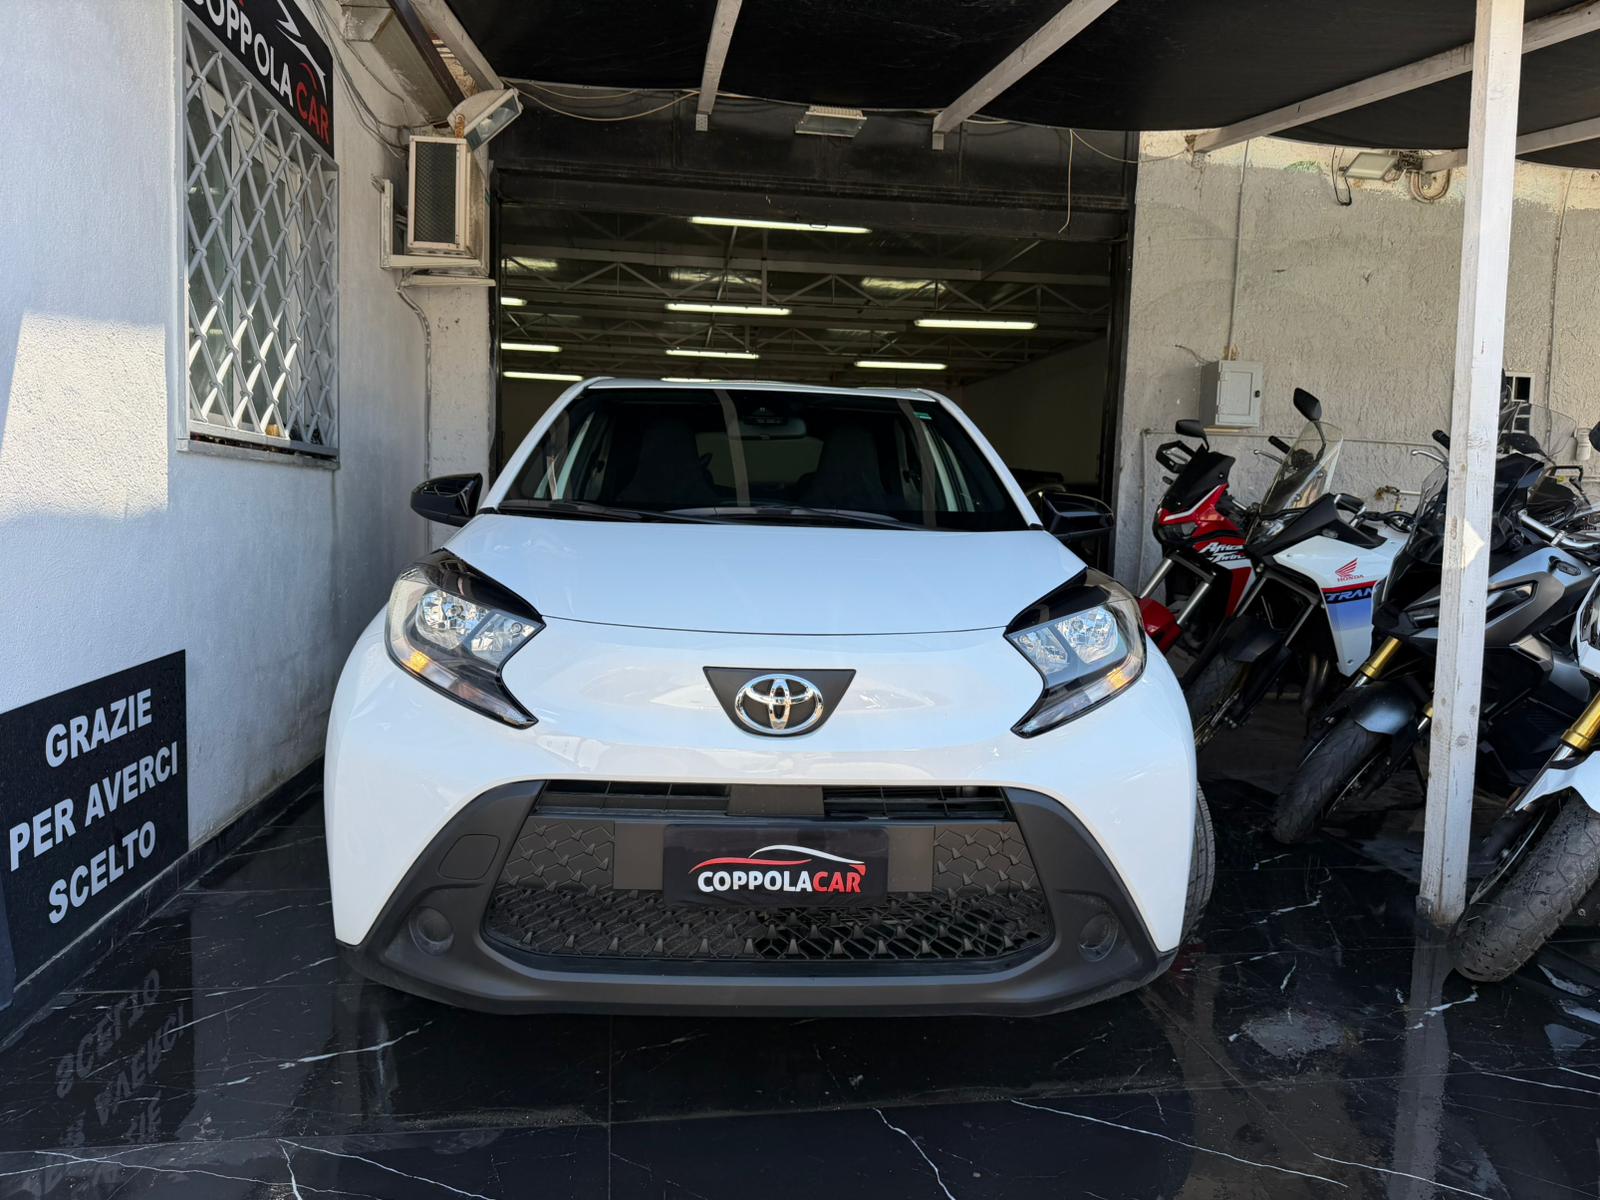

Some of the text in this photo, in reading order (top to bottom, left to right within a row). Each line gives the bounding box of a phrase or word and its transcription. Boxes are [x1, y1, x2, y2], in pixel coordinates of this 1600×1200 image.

[193, 0, 330, 144] OPPOLACAR
[1337, 574, 1365, 583] HONDA
[45, 688, 153, 768] GRAZIE
[9, 741, 179, 872] PER AVERCI
[48, 820, 156, 924] SCELTO
[697, 870, 862, 893] COPPOLACAR
